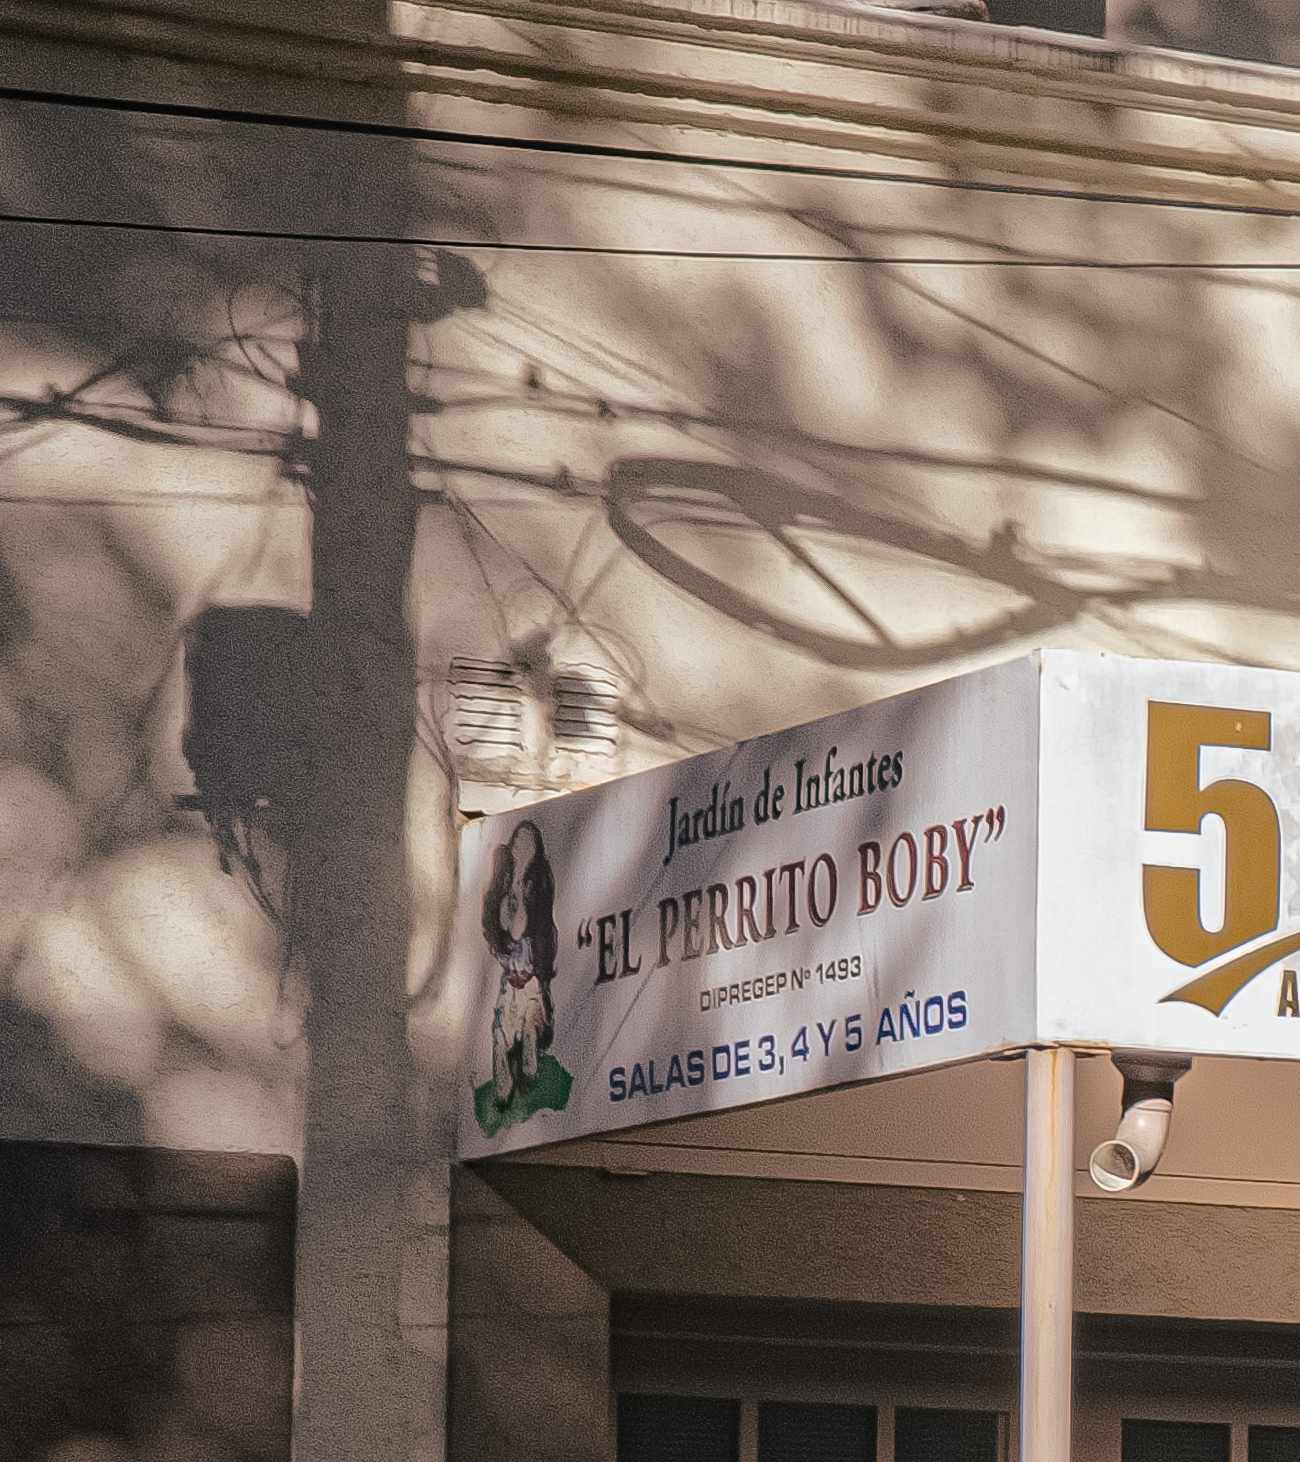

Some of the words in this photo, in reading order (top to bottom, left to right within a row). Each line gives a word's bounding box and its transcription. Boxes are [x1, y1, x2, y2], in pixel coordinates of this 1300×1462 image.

[663, 782, 745, 867] Jardín
[753, 769, 785, 825] de
[794, 746, 905, 813] Infantes
[577, 907, 643, 986] “EL
[656, 852, 839, 970] PERRITO
[856, 804, 1007, 917] BOBY”
[699, 970, 788, 1013] DIPREGEP
[815, 955, 863, 984] 1493
[609, 1049, 705, 1103] SALAS
[712, 1039, 751, 1082] DE
[757, 1034, 786, 1076] 3,
[791, 1025, 811, 1064] 4
[815, 1018, 837, 1058] Y
[844, 1013, 864, 1053] 5
[875, 989, 969, 1045] AÑOS
